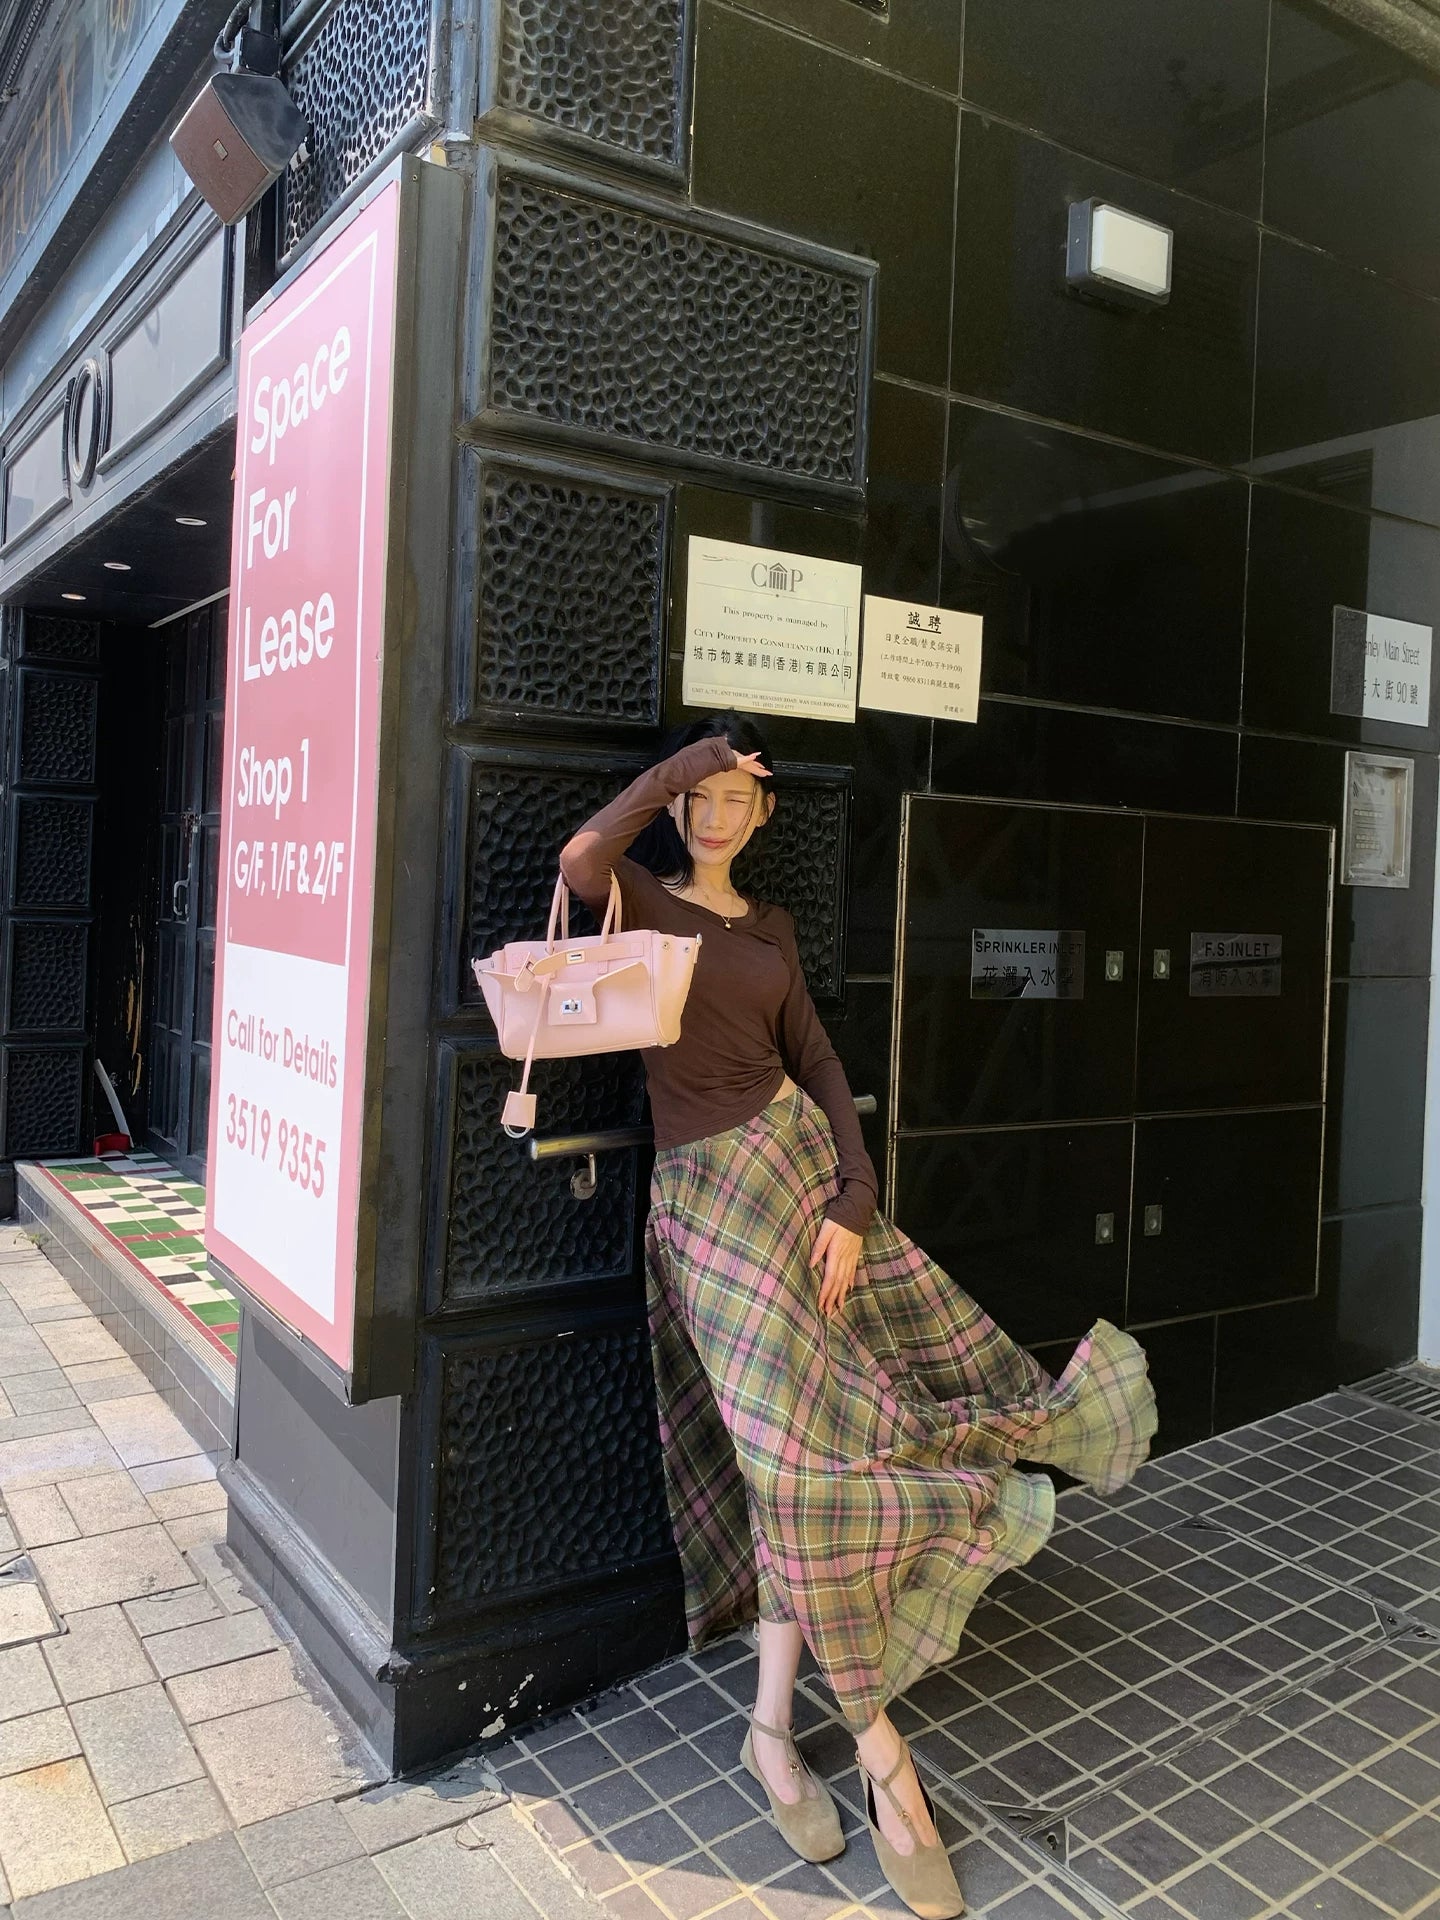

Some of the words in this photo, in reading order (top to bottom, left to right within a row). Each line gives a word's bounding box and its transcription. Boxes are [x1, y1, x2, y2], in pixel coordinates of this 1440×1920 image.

[251, 326, 350, 465] Space
[247, 486, 297, 569] For
[244, 592, 335, 681] Lease
[723, 606, 740, 615] This
[742, 610, 774, 622] property
[785, 617, 818, 628] managed
[820, 621, 829, 629] by
[815, 645, 835, 656] (HK)
[907, 611, 941, 632] 誠聘
[1383, 639, 1400, 661] Main
[1402, 641, 1420, 666] Street
[237, 746, 292, 820] Shop
[300, 738, 309, 802] 1
[975, 941, 1046, 954] SPRINKLER
[1049, 942, 1082, 955] INLET
[227, 1009, 255, 1054] Call
[259, 1018, 279, 1063] for
[283, 1027, 337, 1088] Details
[226, 1093, 271, 1161] 3519
[278, 1118, 327, 1198] 9355
